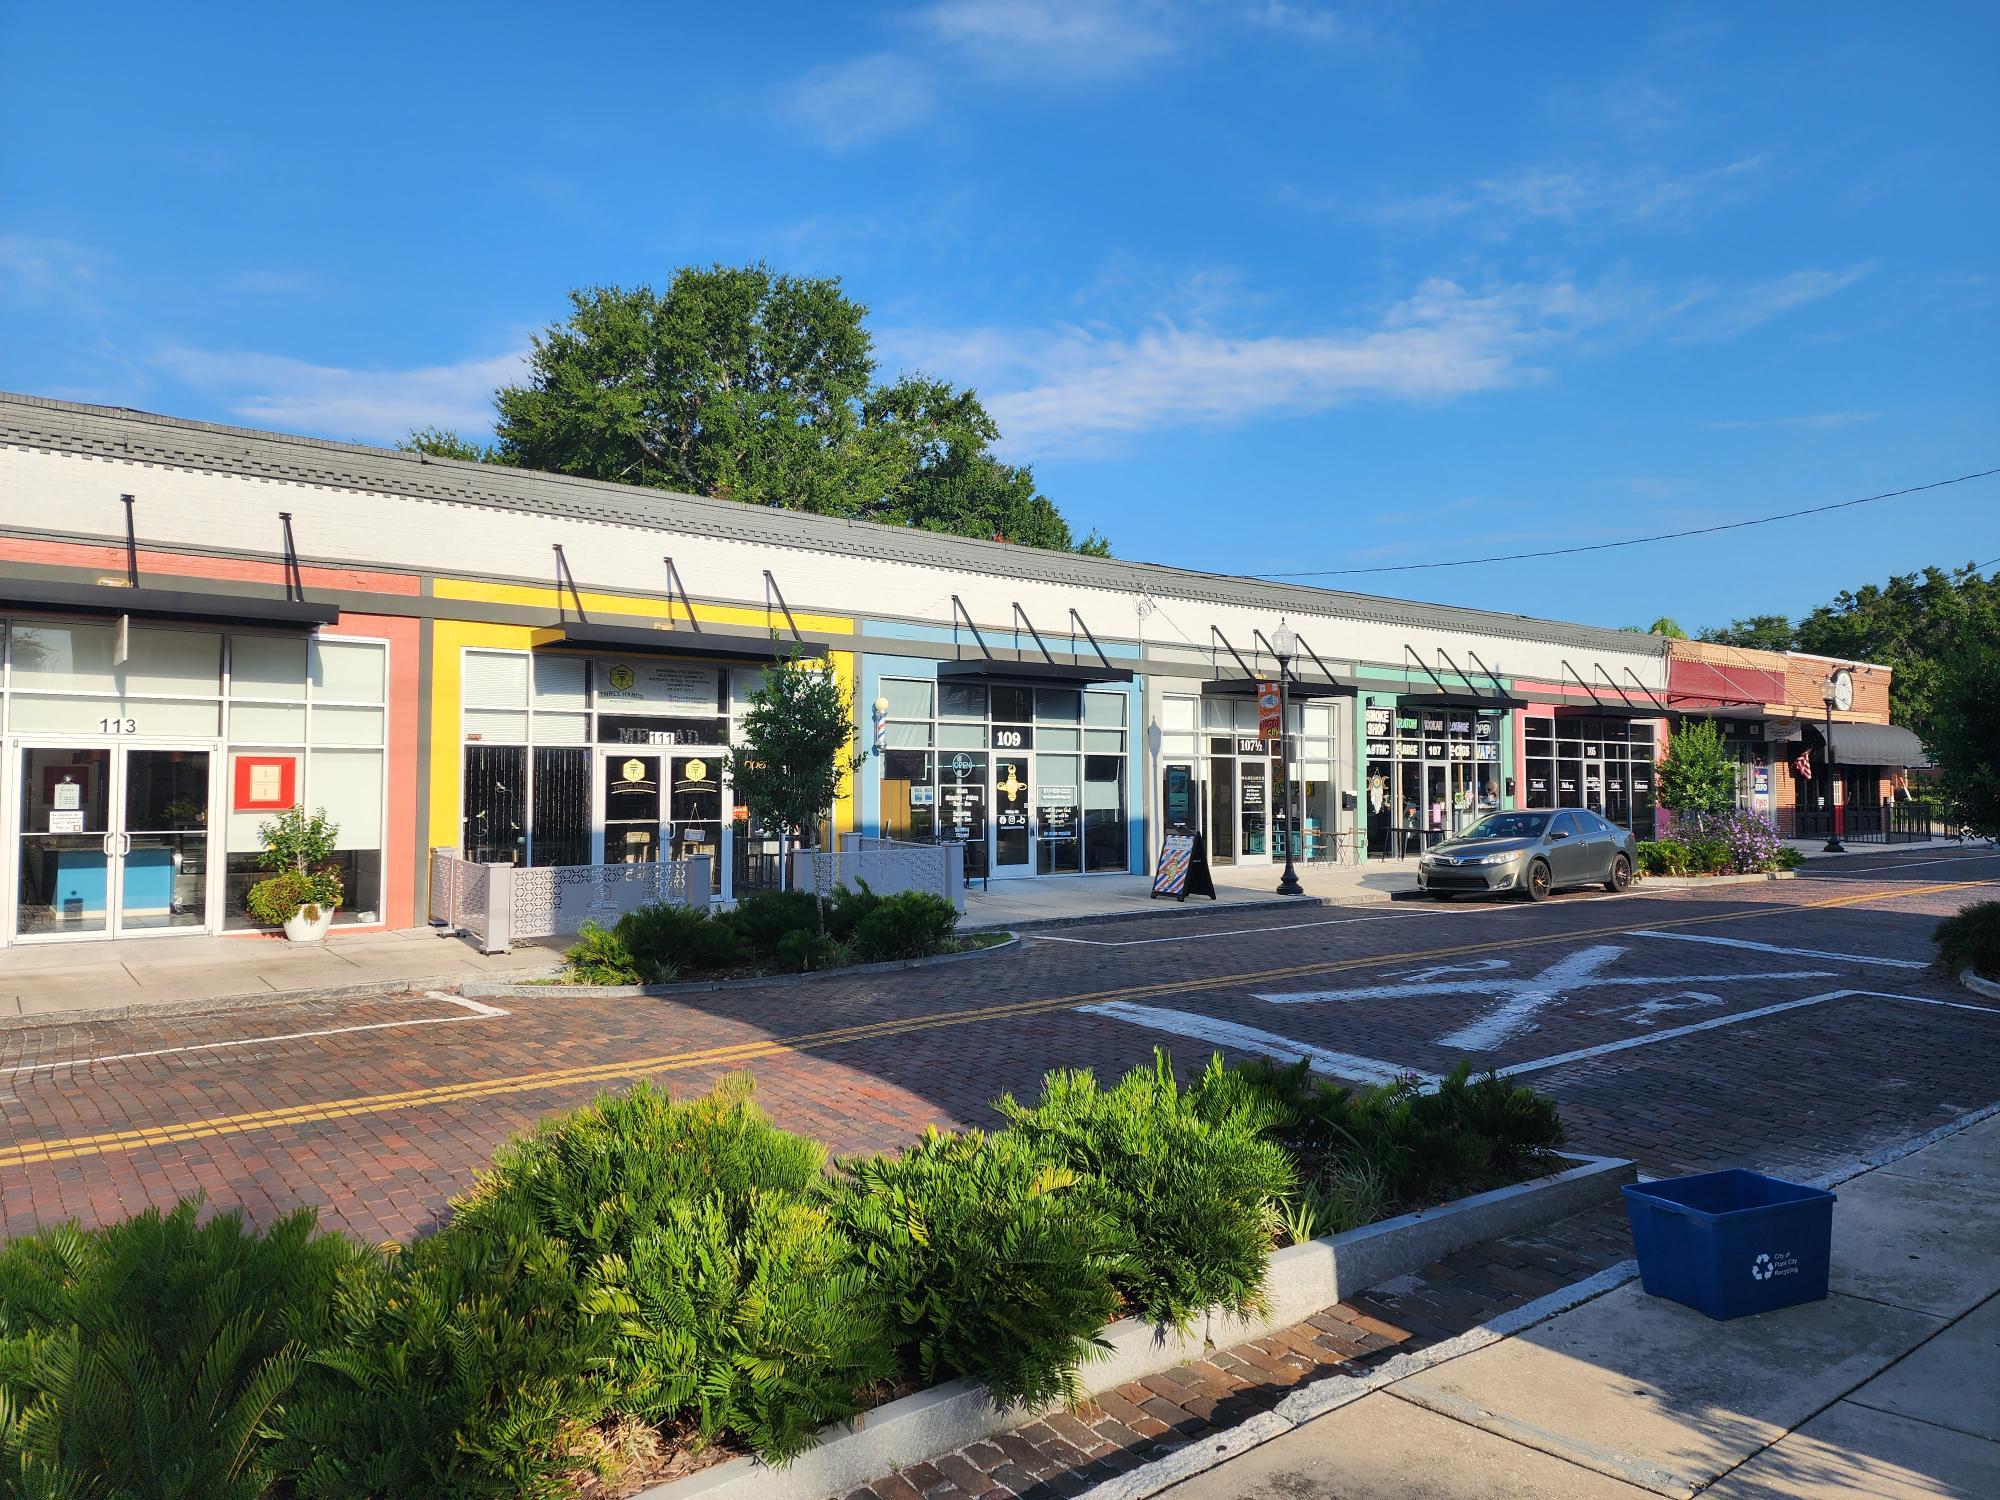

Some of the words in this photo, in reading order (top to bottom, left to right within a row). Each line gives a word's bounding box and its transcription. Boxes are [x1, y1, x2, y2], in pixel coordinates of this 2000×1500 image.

[623, 691, 644, 700] HANDS
[1366, 710, 1389, 722] SMOKE
[100, 718, 136, 733] 113
[1368, 722, 1386, 735] SHOP
[1450, 722, 1469, 732] LOUNGE
[650, 732, 672, 744] 111
[997, 732, 1021, 746] 109
[1428, 746, 1441, 756] 107
[1476, 745, 1496, 759] VAPE
